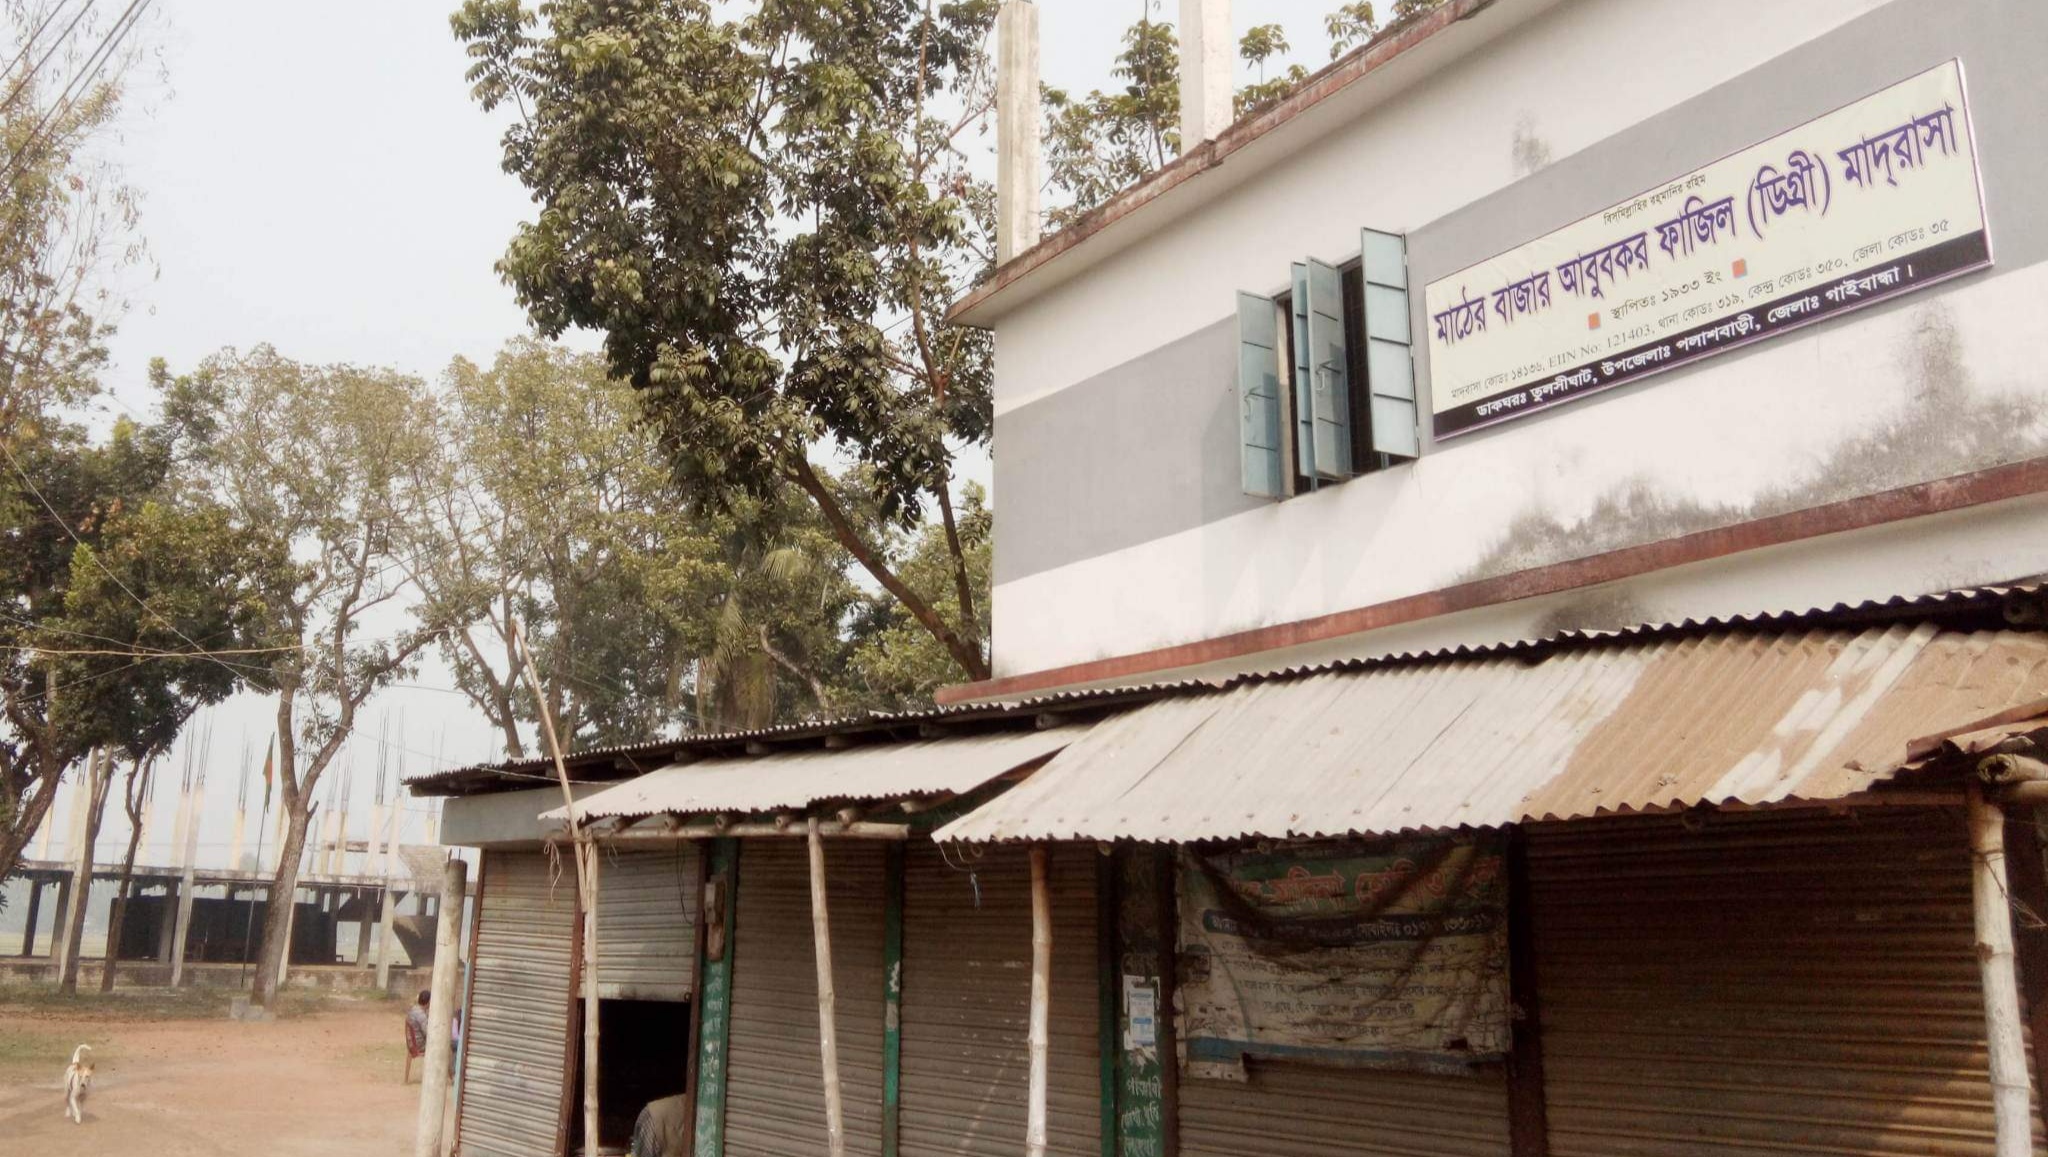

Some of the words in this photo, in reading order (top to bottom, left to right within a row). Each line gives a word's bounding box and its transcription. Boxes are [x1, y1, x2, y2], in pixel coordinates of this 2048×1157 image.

[1434, 284, 1486, 345] মাঠের
[1492, 272, 1551, 323] বাজার
[1556, 232, 1649, 298] আবুবকর
[1655, 196, 1735, 260] ফাজিল
[1747, 151, 1831, 240] (ডিগ্রী)
[1607, 324, 1655, 348] 121403,
[1659, 313, 1680, 329] থানা
[1748, 279, 1774, 299] কেন্দ্র
[1852, 241, 1883, 262] জেলা
[1929, 218, 1949, 234] ৩৫
[1662, 279, 1700, 302] ১৯৩৩
[1704, 270, 1723, 285] ইং
[1530, 368, 1598, 402] তুলসীঘাট,
[1601, 345, 1671, 376] উপজেলাঃ
[1767, 295, 1819, 323] জেলাঃ
[1825, 267, 1900, 303] গাইবান্ধা
